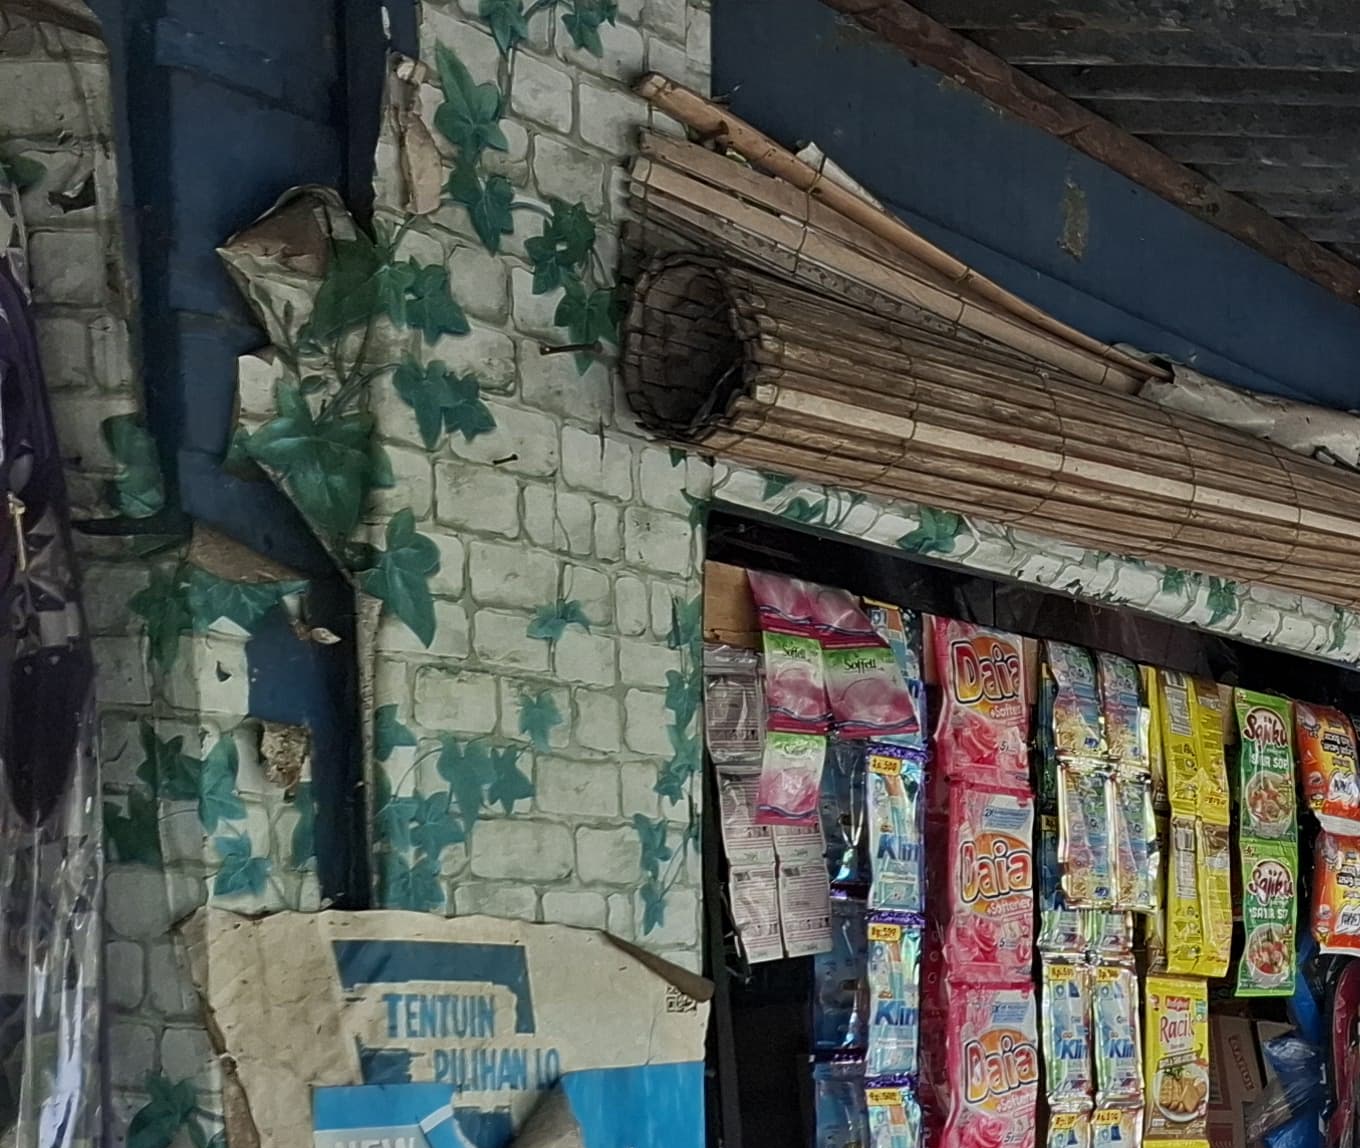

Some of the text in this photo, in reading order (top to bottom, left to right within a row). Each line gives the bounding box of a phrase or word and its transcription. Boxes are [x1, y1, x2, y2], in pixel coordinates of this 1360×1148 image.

[952, 640, 1019, 703] Daia
[960, 839, 1032, 903] Daia
[382, 993, 495, 1038] TENTUIN
[1160, 1012, 1195, 1044] Racik
[964, 1035, 1038, 1104] Daia
